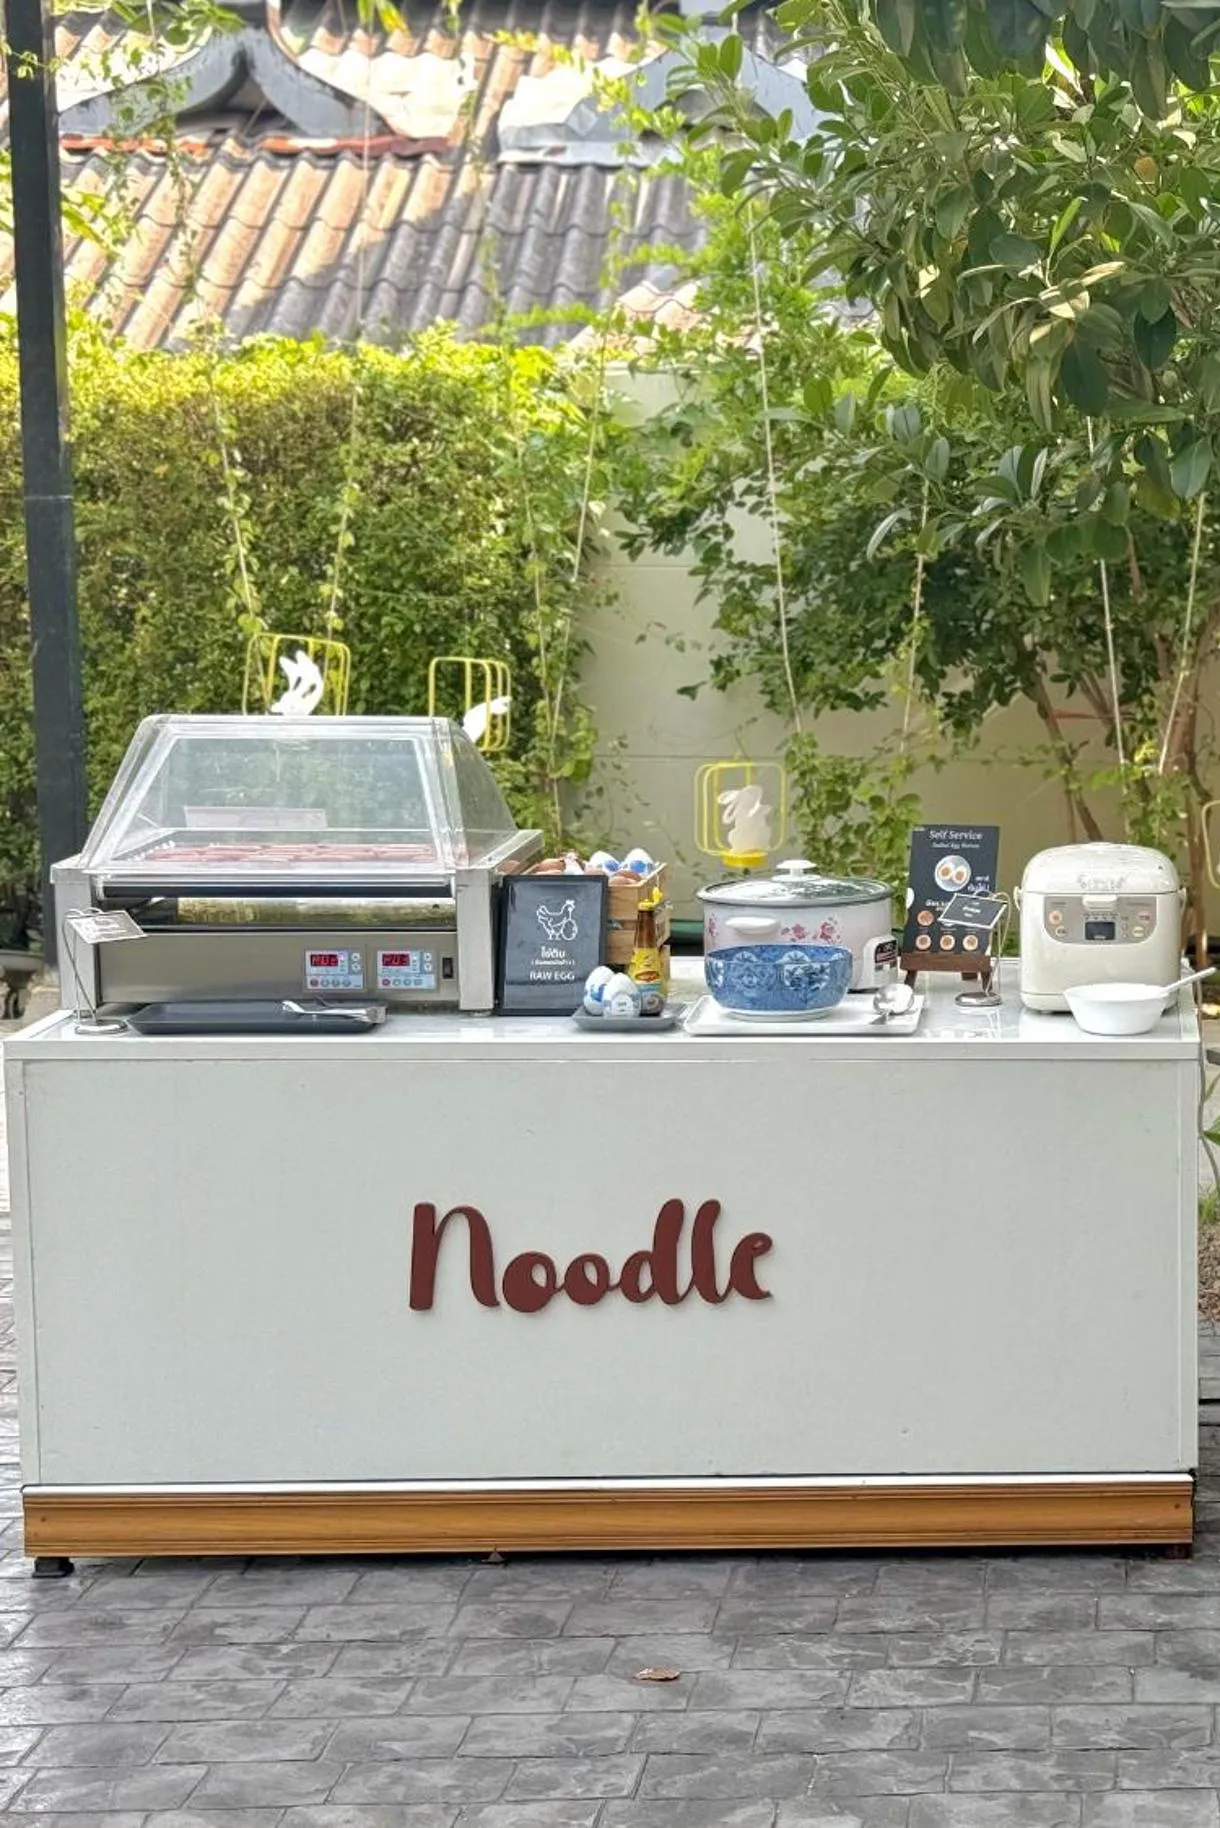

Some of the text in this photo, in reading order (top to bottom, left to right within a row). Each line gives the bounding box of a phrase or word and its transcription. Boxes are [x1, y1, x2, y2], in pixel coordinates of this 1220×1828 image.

[929, 829, 983, 840] Self Service
[530, 970, 575, 981] RAW EGG
[410, 1199, 773, 1313] Noodle
